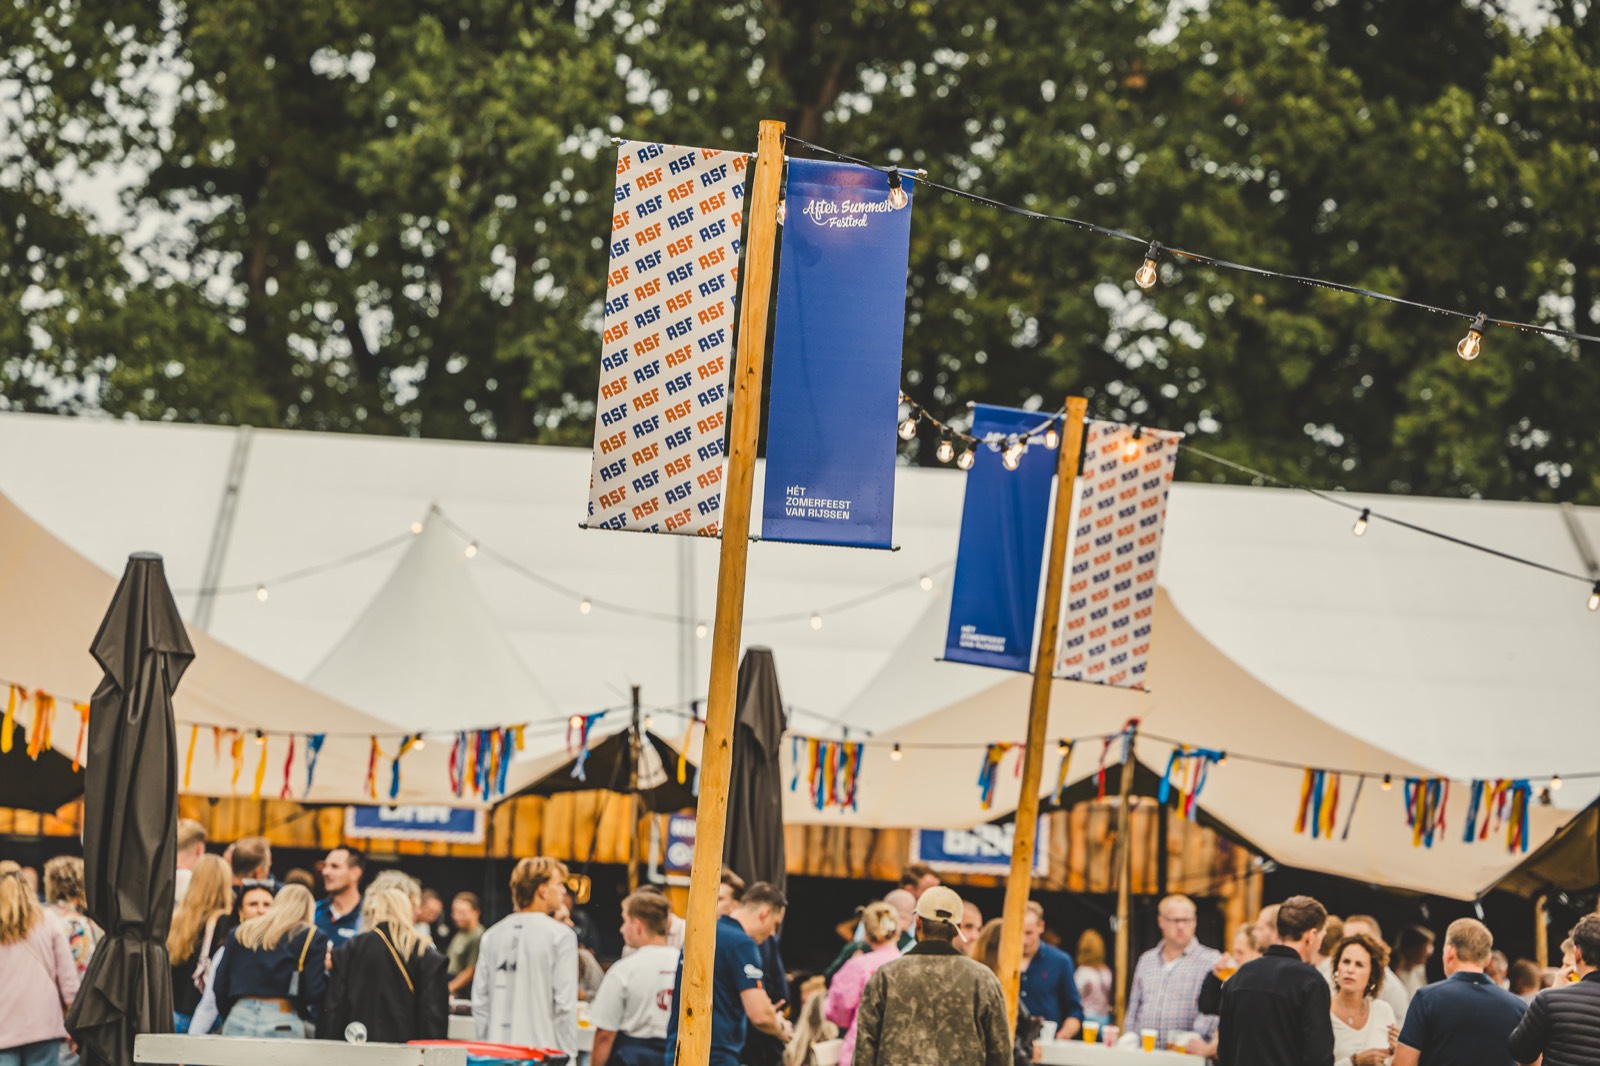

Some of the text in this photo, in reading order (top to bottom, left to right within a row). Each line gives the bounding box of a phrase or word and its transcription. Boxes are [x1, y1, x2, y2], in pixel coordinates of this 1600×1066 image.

[617, 155, 630, 175] SF
[637, 144, 663, 163] ASF
[669, 152, 695, 175] ASF
[636, 167, 662, 191] ASF
[700, 164, 727, 187] ASF
[613, 183, 630, 204] SF
[667, 180, 694, 203] ASF
[699, 192, 726, 215] ASF
[636, 195, 662, 218] ASF
[667, 207, 694, 230] ASF
[802, 199, 894, 222] After Summer
[611, 210, 630, 232] SF
[699, 219, 725, 242] ASF
[829, 214, 868, 228] Festival
[635, 223, 661, 246] ASF
[666, 234, 693, 258] ASF
[635, 250, 661, 274] ASF
[698, 246, 725, 270] ASF
[667, 262, 693, 286] ASF
[698, 274, 725, 297] ASF
[634, 277, 661, 302] ASF
[666, 289, 692, 313] ASF
[605, 293, 629, 317] ASF
[634, 305, 660, 329] ASF
[697, 301, 724, 325] ASF
[603, 321, 628, 345] ASF
[666, 317, 692, 340] ASF
[698, 328, 724, 352] ASF
[633, 333, 660, 357] ASF
[665, 344, 692, 368] ASF
[601, 348, 628, 372] ASF
[633, 360, 659, 384] ASF
[697, 356, 724, 380] ASF
[601, 376, 628, 400] ASF
[665, 372, 692, 396] ASF
[697, 383, 724, 407] ASF
[632, 388, 659, 412] ASF
[664, 399, 691, 423] ASF
[601, 403, 627, 427] ASF
[632, 415, 659, 439] ASF
[697, 411, 724, 434] ASF
[600, 431, 626, 454] ASF
[665, 426, 691, 450] ASF
[697, 438, 724, 462] ASF
[632, 443, 658, 466] ASF
[664, 454, 691, 477] ASF
[600, 458, 626, 482] ASF
[632, 469, 659, 493] ASF
[599, 485, 626, 509] ASF
[665, 481, 691, 505] ASF
[786, 485, 806, 496] HÉT
[632, 497, 658, 520] ASF
[697, 493, 720, 516] AS
[785, 497, 851, 509] ZOMERFEEST
[785, 508, 850, 520] VAN RIJSSEN
[664, 508, 691, 530] ASF
